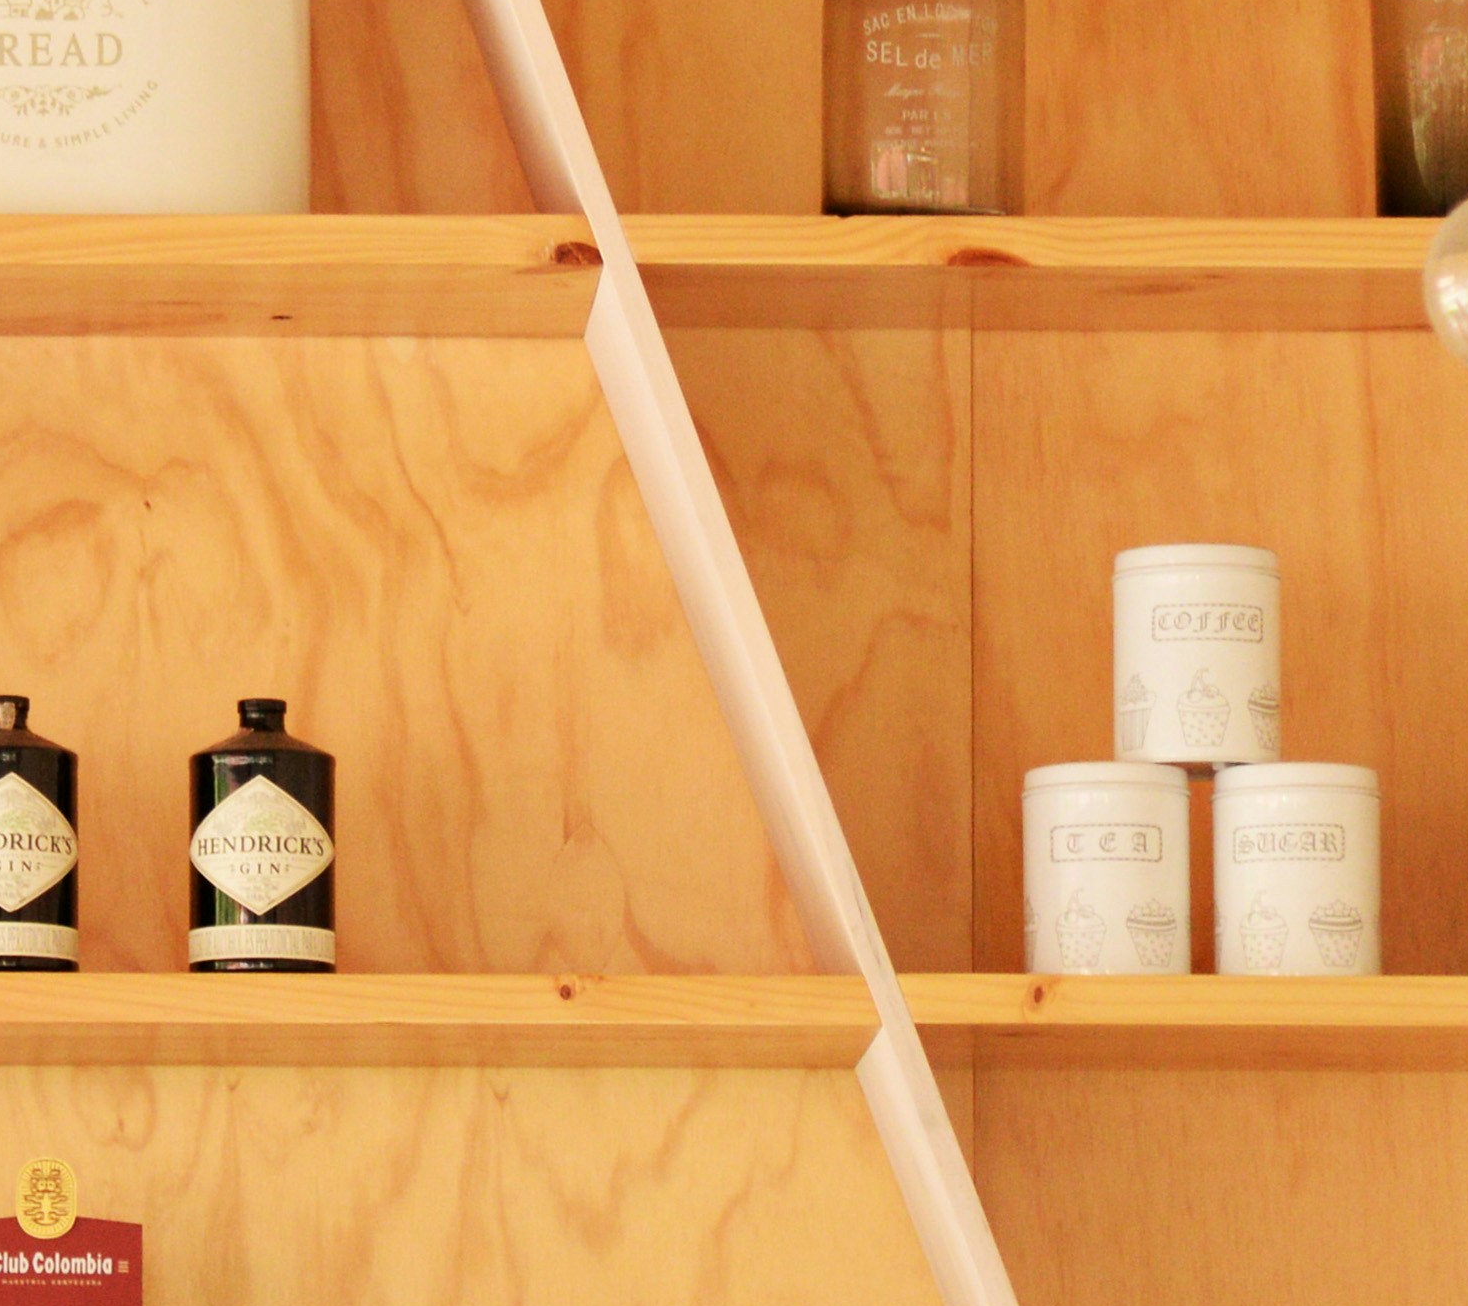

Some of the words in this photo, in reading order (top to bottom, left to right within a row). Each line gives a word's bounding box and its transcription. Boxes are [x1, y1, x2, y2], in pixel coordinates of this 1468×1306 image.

[895, 3, 916, 24] EN
[866, 39, 909, 67] SEL
[915, 48, 942, 70] de
[951, 43, 994, 67] MER
[37, 136, 47, 150] &
[53, 124, 112, 150] SIMPLE
[114, 78, 160, 131] LIVING
[1157, 609, 1260, 634] COFFEE
[197, 835, 325, 858] HENDRICK'S
[1066, 830, 1150, 854] TEA
[1238, 830, 1341, 855] SUGAR
[239, 862, 280, 876] GIN
[32, 1251, 114, 1275] Colombia
